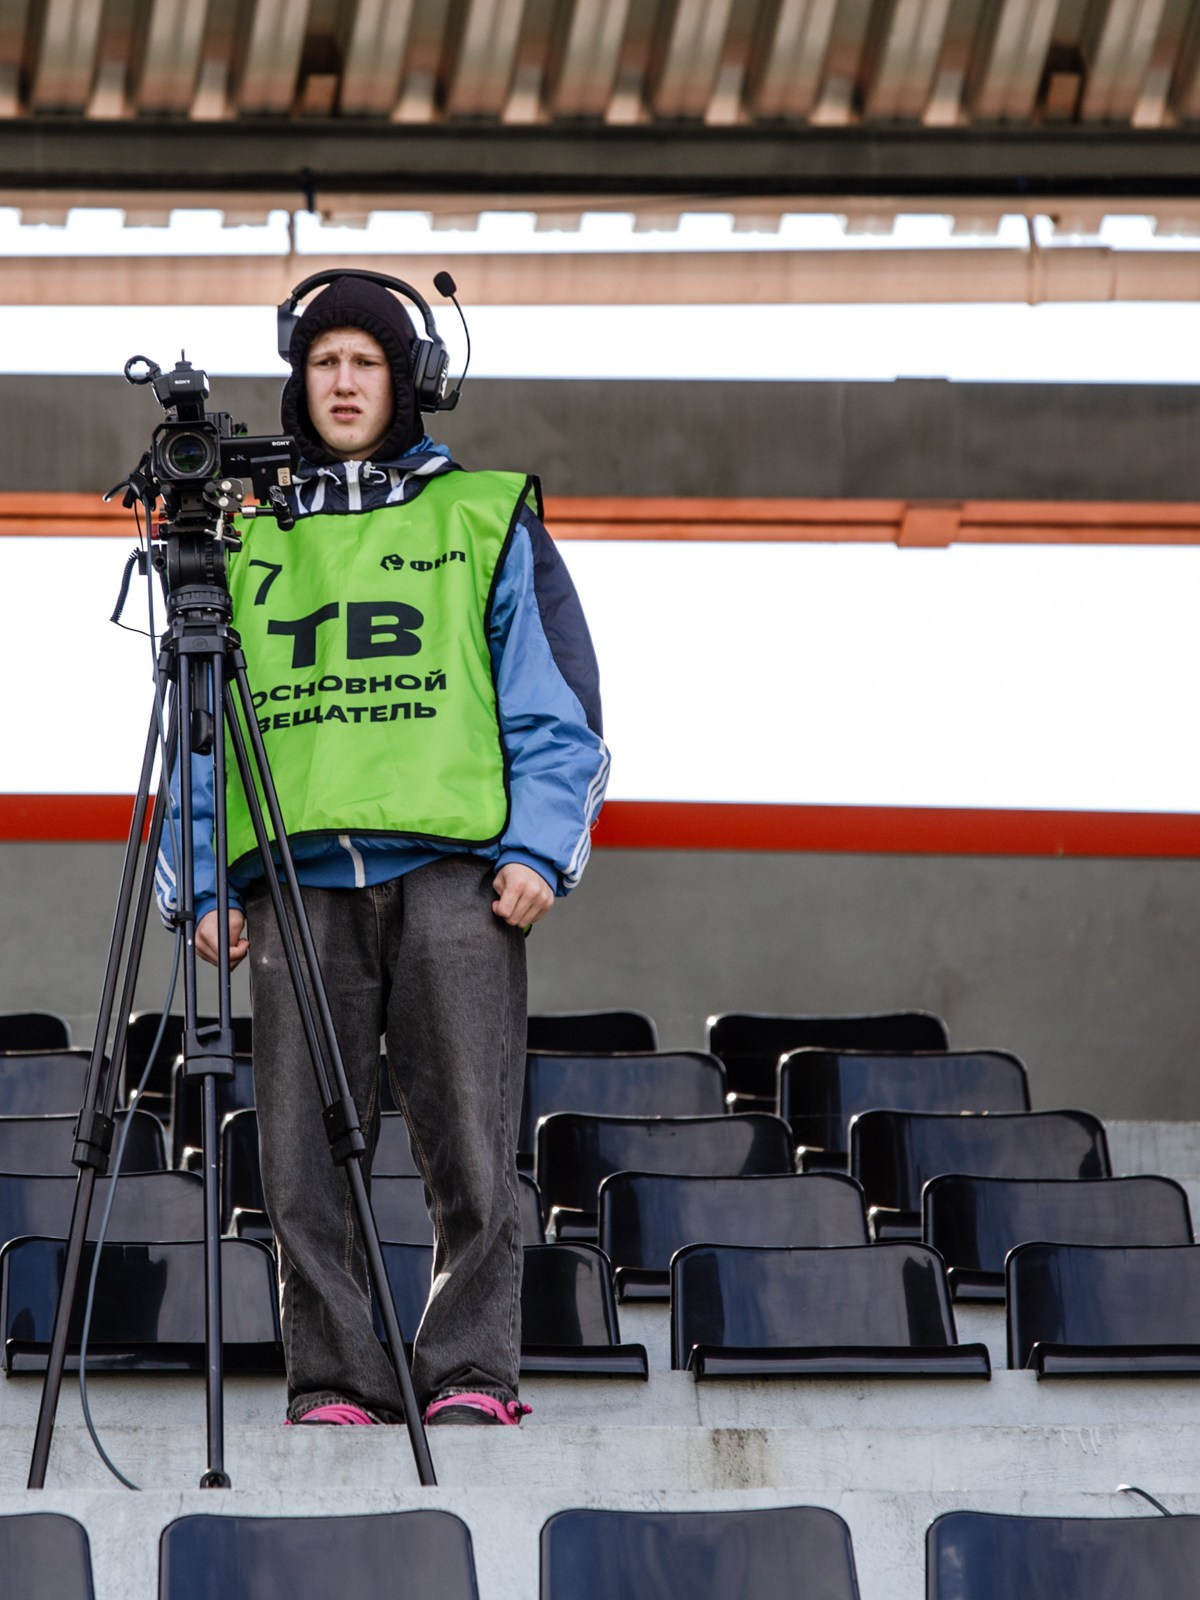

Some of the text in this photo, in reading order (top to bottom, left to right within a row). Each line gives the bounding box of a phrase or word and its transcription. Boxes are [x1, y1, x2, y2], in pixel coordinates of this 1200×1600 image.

[248, 559, 283, 606] 7
[266, 600, 425, 670] ТВ
[251, 668, 448, 710] ОСНОВНОЙ
